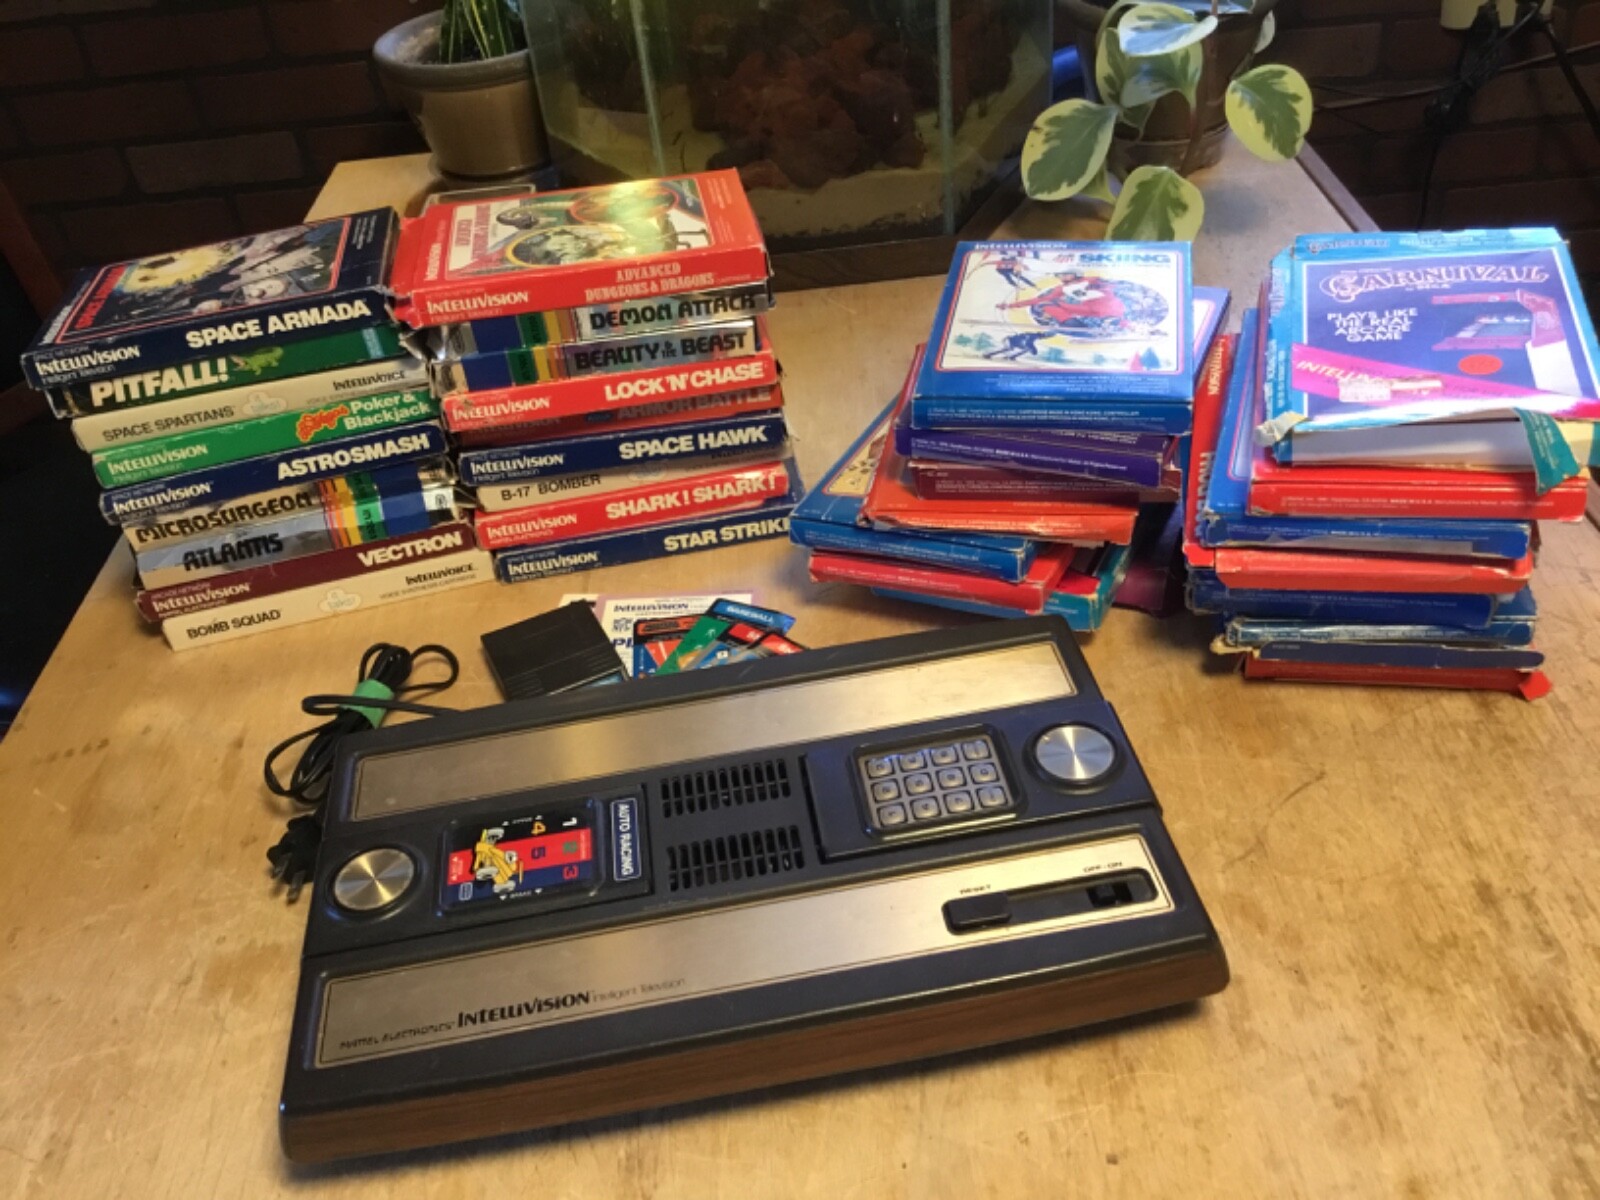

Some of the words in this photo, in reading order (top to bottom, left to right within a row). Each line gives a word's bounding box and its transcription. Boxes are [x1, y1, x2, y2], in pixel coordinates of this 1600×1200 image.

[615, 262, 681, 283] ADVANCED
[1078, 253, 1171, 264] SKIING
[585, 277, 650, 301] DUNGEONS
[660, 272, 715, 292] DRAGONS
[1319, 265, 1550, 302] CARNIVAL
[427, 290, 529, 315] INTELLIVISION
[590, 302, 674, 331] DEMON
[677, 293, 756, 318] ATTACK
[1327, 309, 1379, 321] PLAYS
[1386, 307, 1418, 318] LIKE
[186, 319, 263, 348] SPACE
[267, 298, 371, 335] ARMADA
[1335, 318, 1361, 328] THE
[1371, 316, 1413, 327] REAL
[1335, 324, 1411, 336] ARCADE
[575, 343, 659, 370] BEAUTY
[680, 331, 747, 357] BEAST
[1346, 332, 1402, 343] GAME
[35, 345, 140, 376] INTELLIVISION
[90, 355, 229, 406] PITFALL!
[332, 371, 406, 391] INTELLIVOICE
[604, 376, 665, 402] LOCK
[691, 361, 764, 385] CHASE
[344, 402, 430, 431] Blackjack
[351, 395, 400, 414] Poker
[403, 392, 416, 403] &
[452, 396, 550, 421] INTELLIVISION
[618, 398, 692, 420] ARMOR
[699, 386, 772, 409] BATTLE
[103, 421, 152, 442] SPACE
[155, 405, 234, 433] SPARTANS
[278, 432, 430, 480] ASTROSMASH
[619, 434, 695, 460] SPACE
[697, 424, 769, 450] HAWK
[107, 443, 208, 476] INTELLIVISION
[470, 452, 565, 475] INTELLIVISION
[113, 481, 212, 515] INTELLIVISION
[500, 486, 531, 502] B-17
[537, 473, 602, 495] BOMBER
[135, 490, 313, 544] MICROSURGEON
[486, 512, 578, 538] INTELLIVISION
[182, 533, 283, 571] ATLANTIS
[357, 531, 463, 568] VECTRON
[663, 529, 717, 552] STAR
[405, 563, 474, 585] INTELLIVOICE
[508, 549, 598, 576] INTELLIVISION
[152, 580, 251, 613] INTELLIVISION
[186, 619, 230, 640] BOMB
[231, 609, 281, 631] SQUAD
[531, 821, 547, 836] 4
[618, 804, 632, 832] AUTO
[531, 846, 546, 860] 5
[619, 833, 634, 878] RACING
[562, 865, 579, 880] 3
[339, 1035, 380, 1051] MATTEL
[382, 1021, 452, 1045] ELECTRONICS
[457, 989, 590, 1029] INTELLIVISION
[592, 987, 637, 1004] Intelligent
[640, 976, 685, 995] Television
